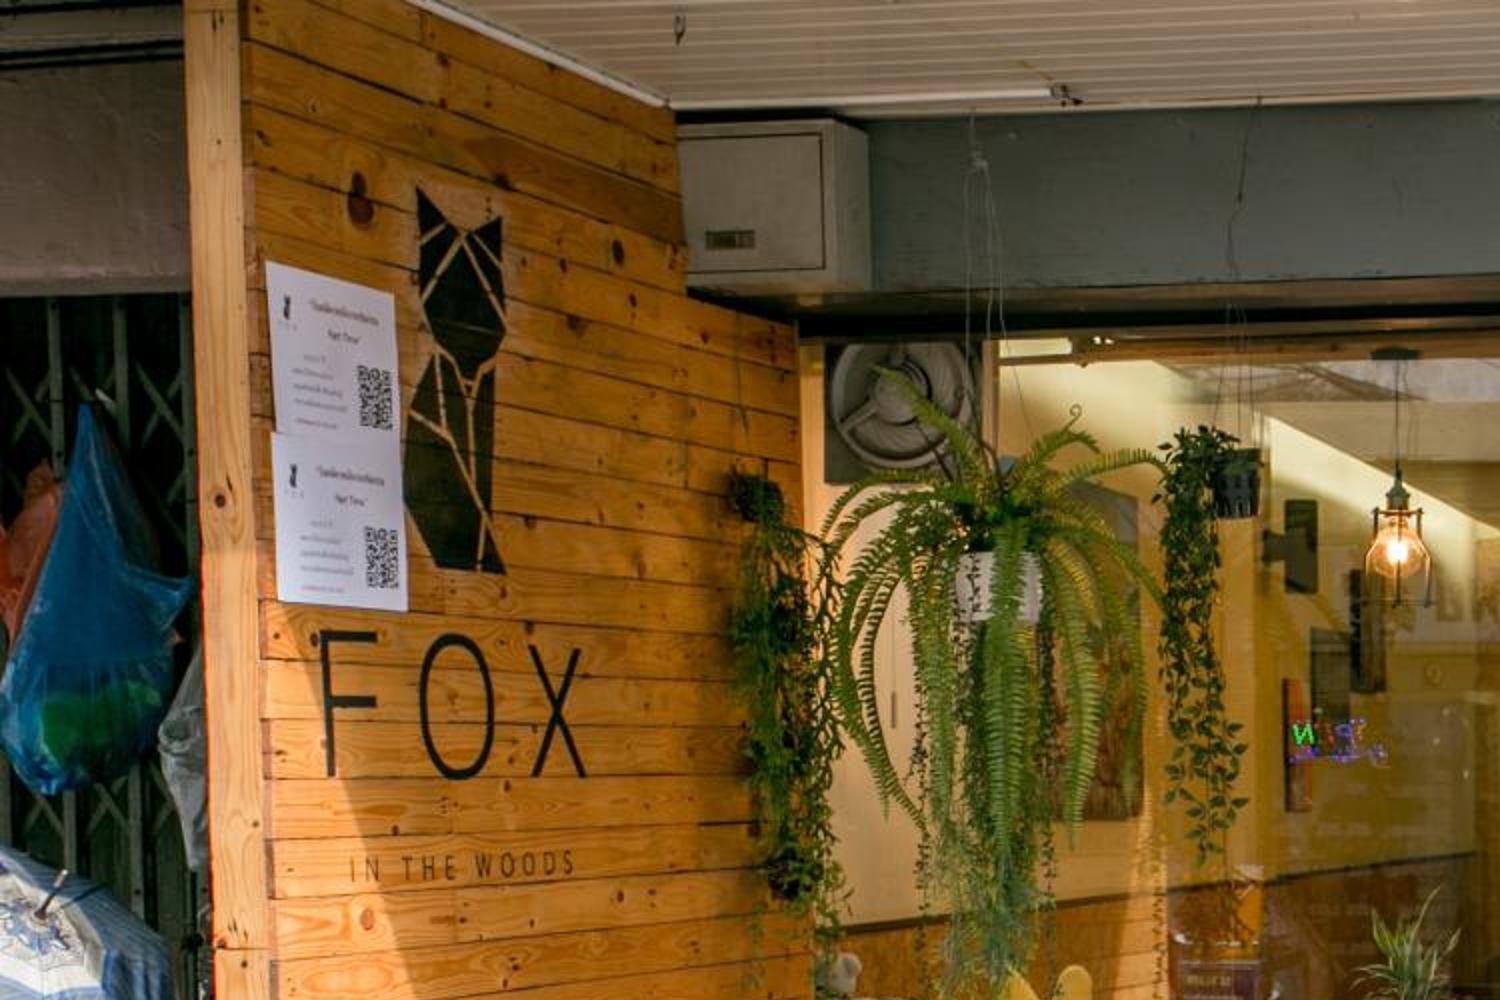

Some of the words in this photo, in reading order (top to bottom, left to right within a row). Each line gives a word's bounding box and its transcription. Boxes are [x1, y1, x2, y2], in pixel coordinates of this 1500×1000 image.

[319, 629, 588, 781] FOX
[351, 855, 380, 882] IN
[401, 855, 458, 881] THE
[474, 849, 574, 878] WOODS
